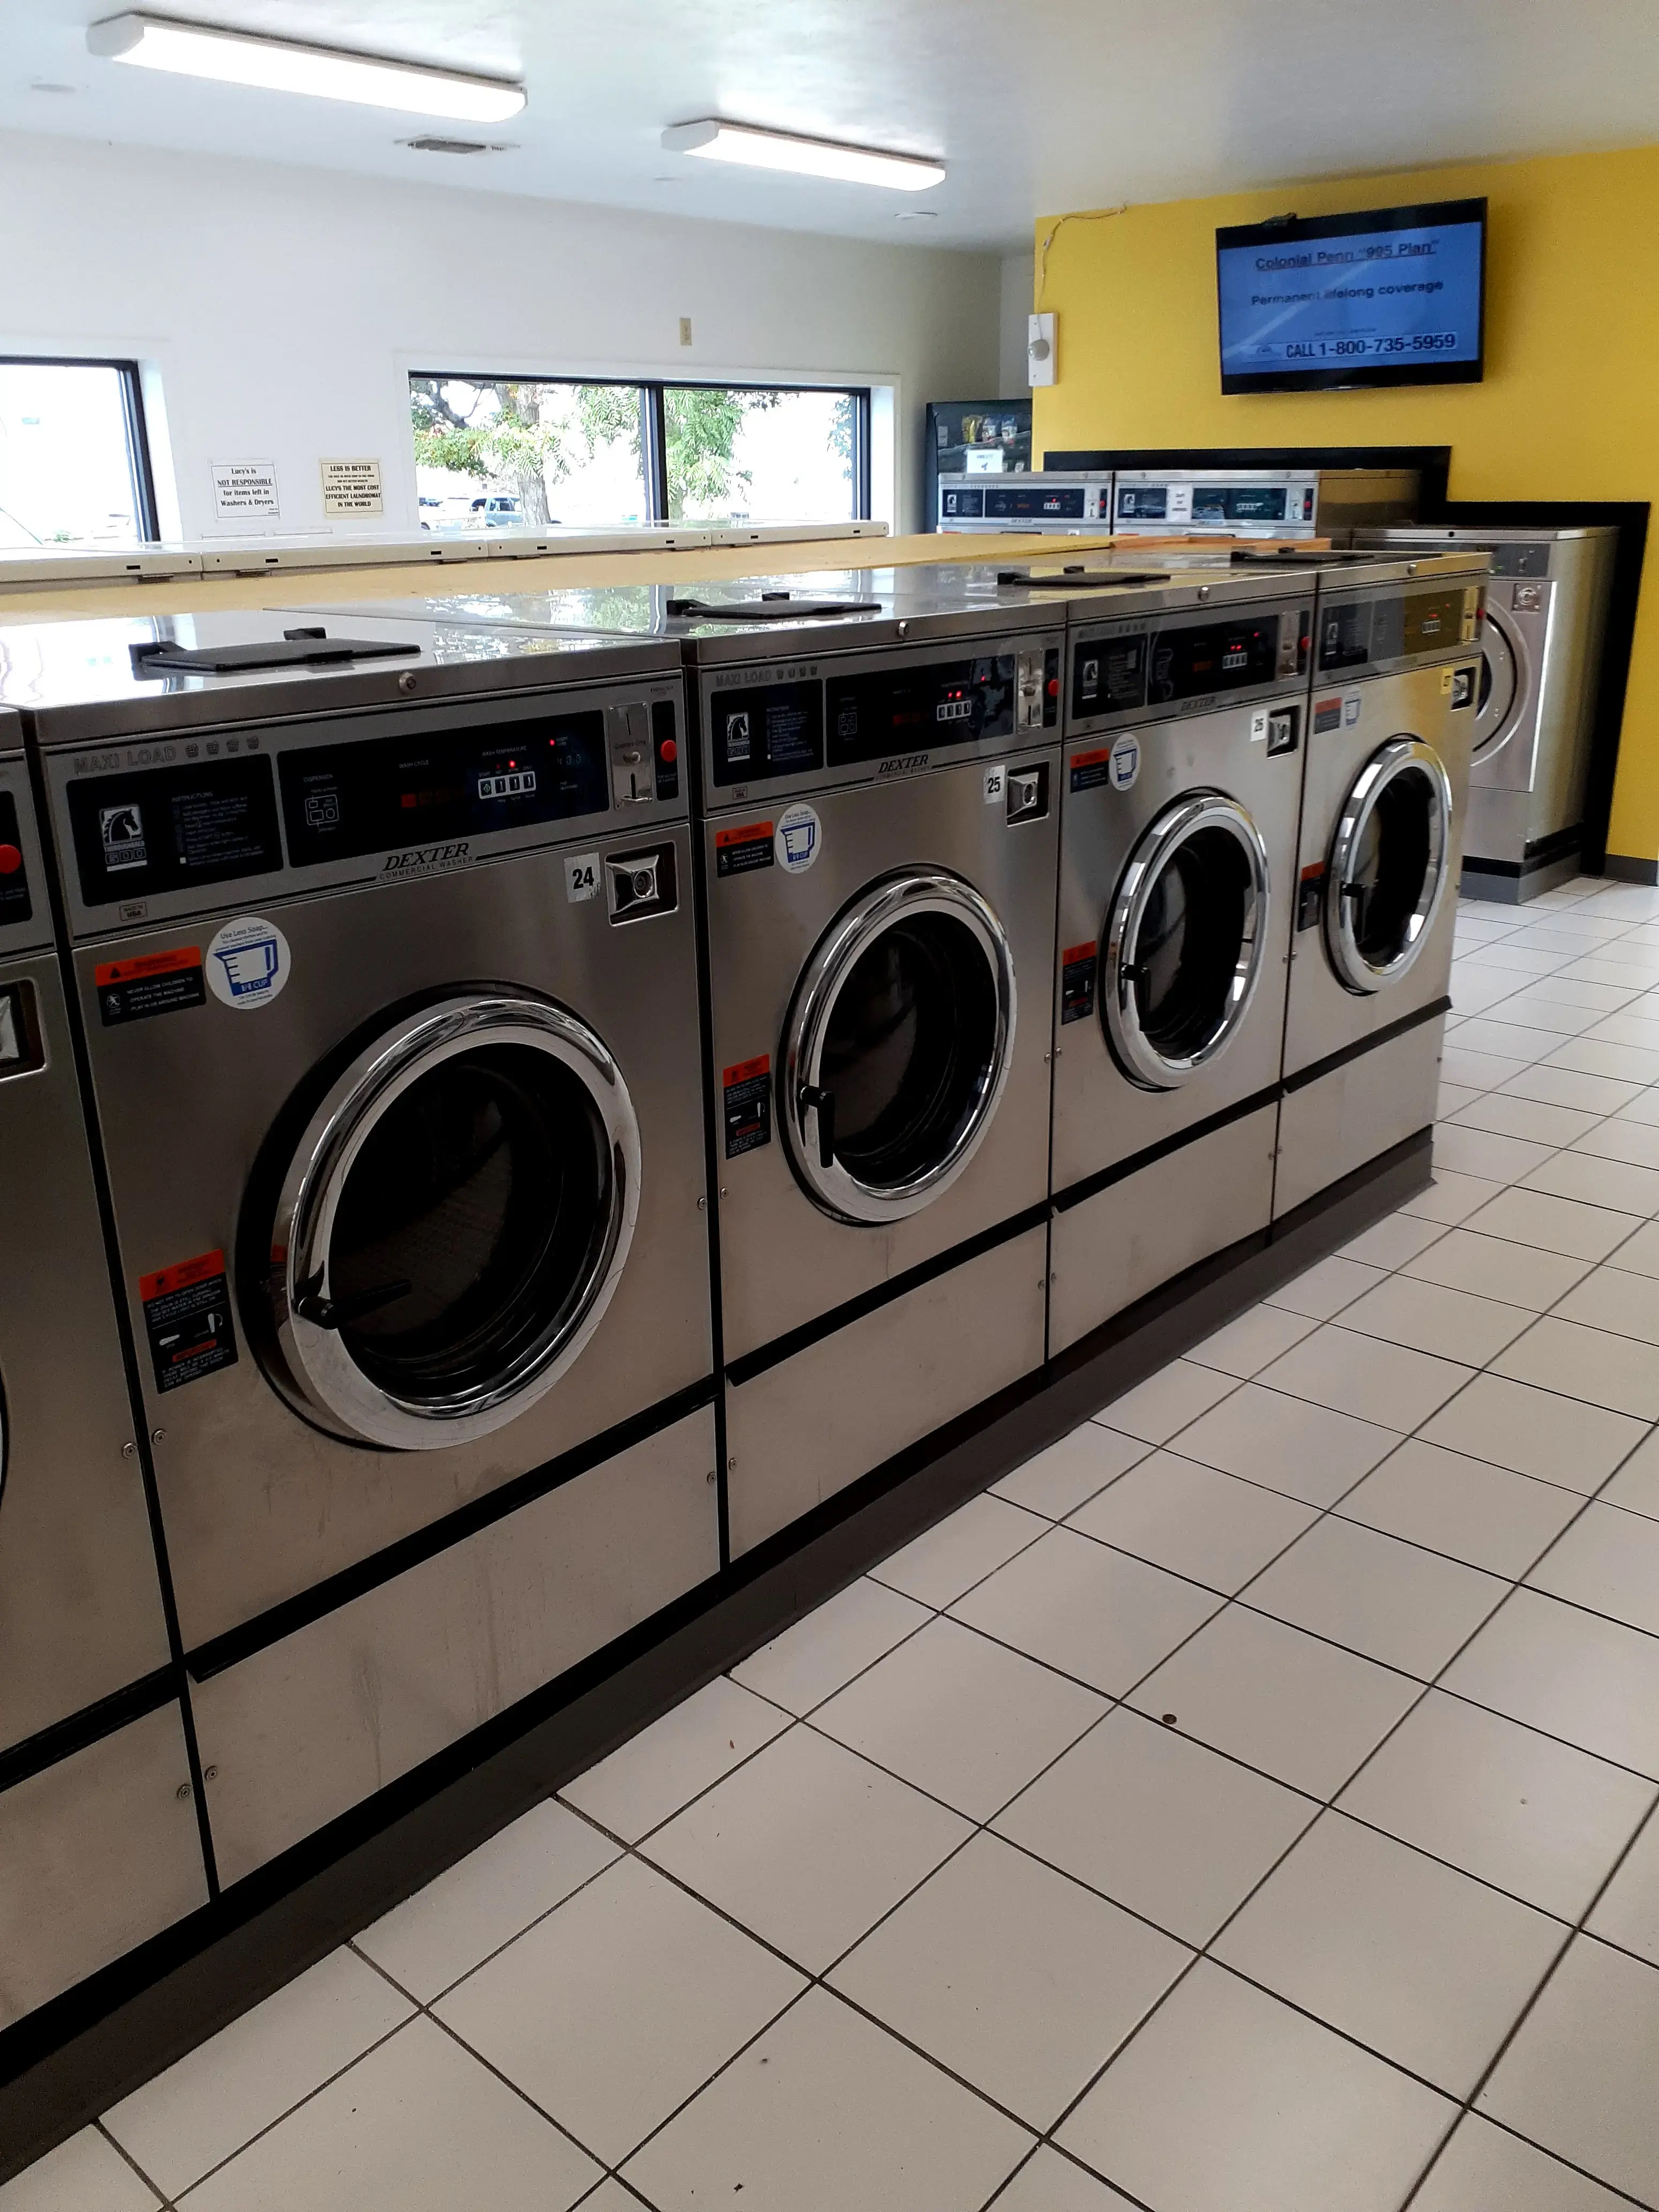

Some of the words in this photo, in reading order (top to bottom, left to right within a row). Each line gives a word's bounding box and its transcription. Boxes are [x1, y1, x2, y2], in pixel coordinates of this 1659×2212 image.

[1255, 253, 1312, 269] Colonial
[1317, 251, 1354, 263] Penn
[1378, 280, 1444, 295] coverage
[1286, 342, 1316, 358] CALL
[1320, 334, 1455, 355] 1-800-735-5959
[715, 674, 741, 686] MAXI
[744, 670, 772, 683] LOAD
[74, 753, 119, 773] MAXI
[126, 745, 176, 766] LOAD
[496, 745, 527, 755] TEMPERATURE
[414, 759, 430, 767] CYCLE
[879, 754, 929, 773] DEXTER
[987, 776, 1000, 794] 25
[383, 842, 469, 871] DEXTER
[379, 864, 435, 880] COMMERCIAL
[439, 857, 473, 868] WASHER
[572, 866, 594, 890] 24
[126, 910, 143, 918] USA
[253, 979, 268, 989] CUP
